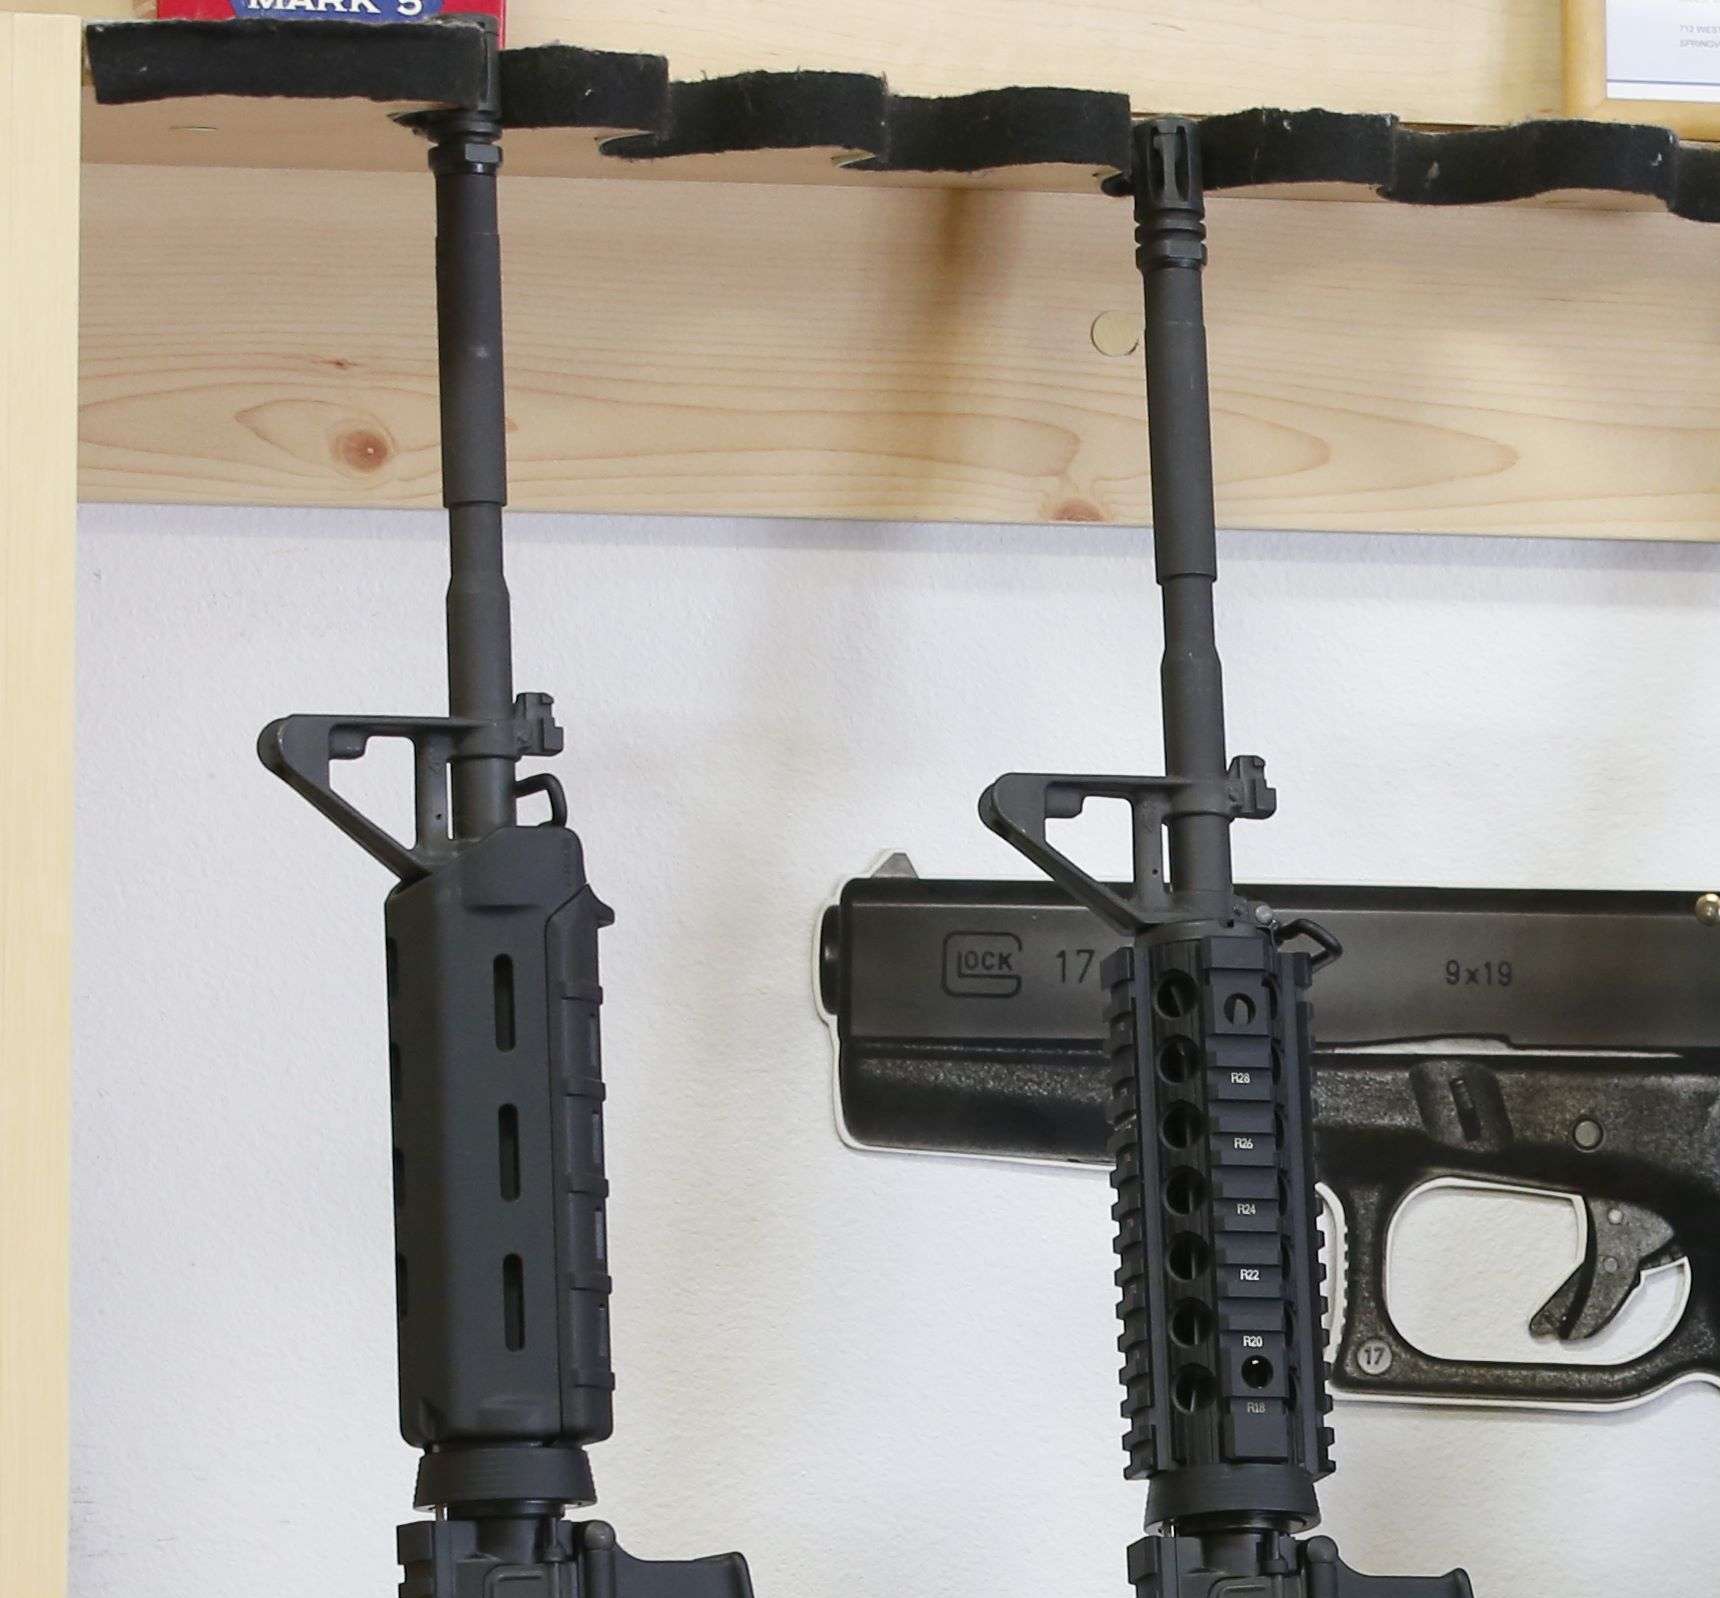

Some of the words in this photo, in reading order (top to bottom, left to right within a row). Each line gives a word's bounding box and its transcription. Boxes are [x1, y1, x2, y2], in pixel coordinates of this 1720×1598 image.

[1056, 948, 1096, 984] 17
[1445, 960, 1513, 987] 9x19
[1234, 1137, 1254, 1150] R26
[1237, 1203, 1257, 1216] R24
[1240, 1268, 1260, 1282] R22
[1243, 1335, 1263, 1348] R20
[1364, 1345, 1386, 1366] 17
